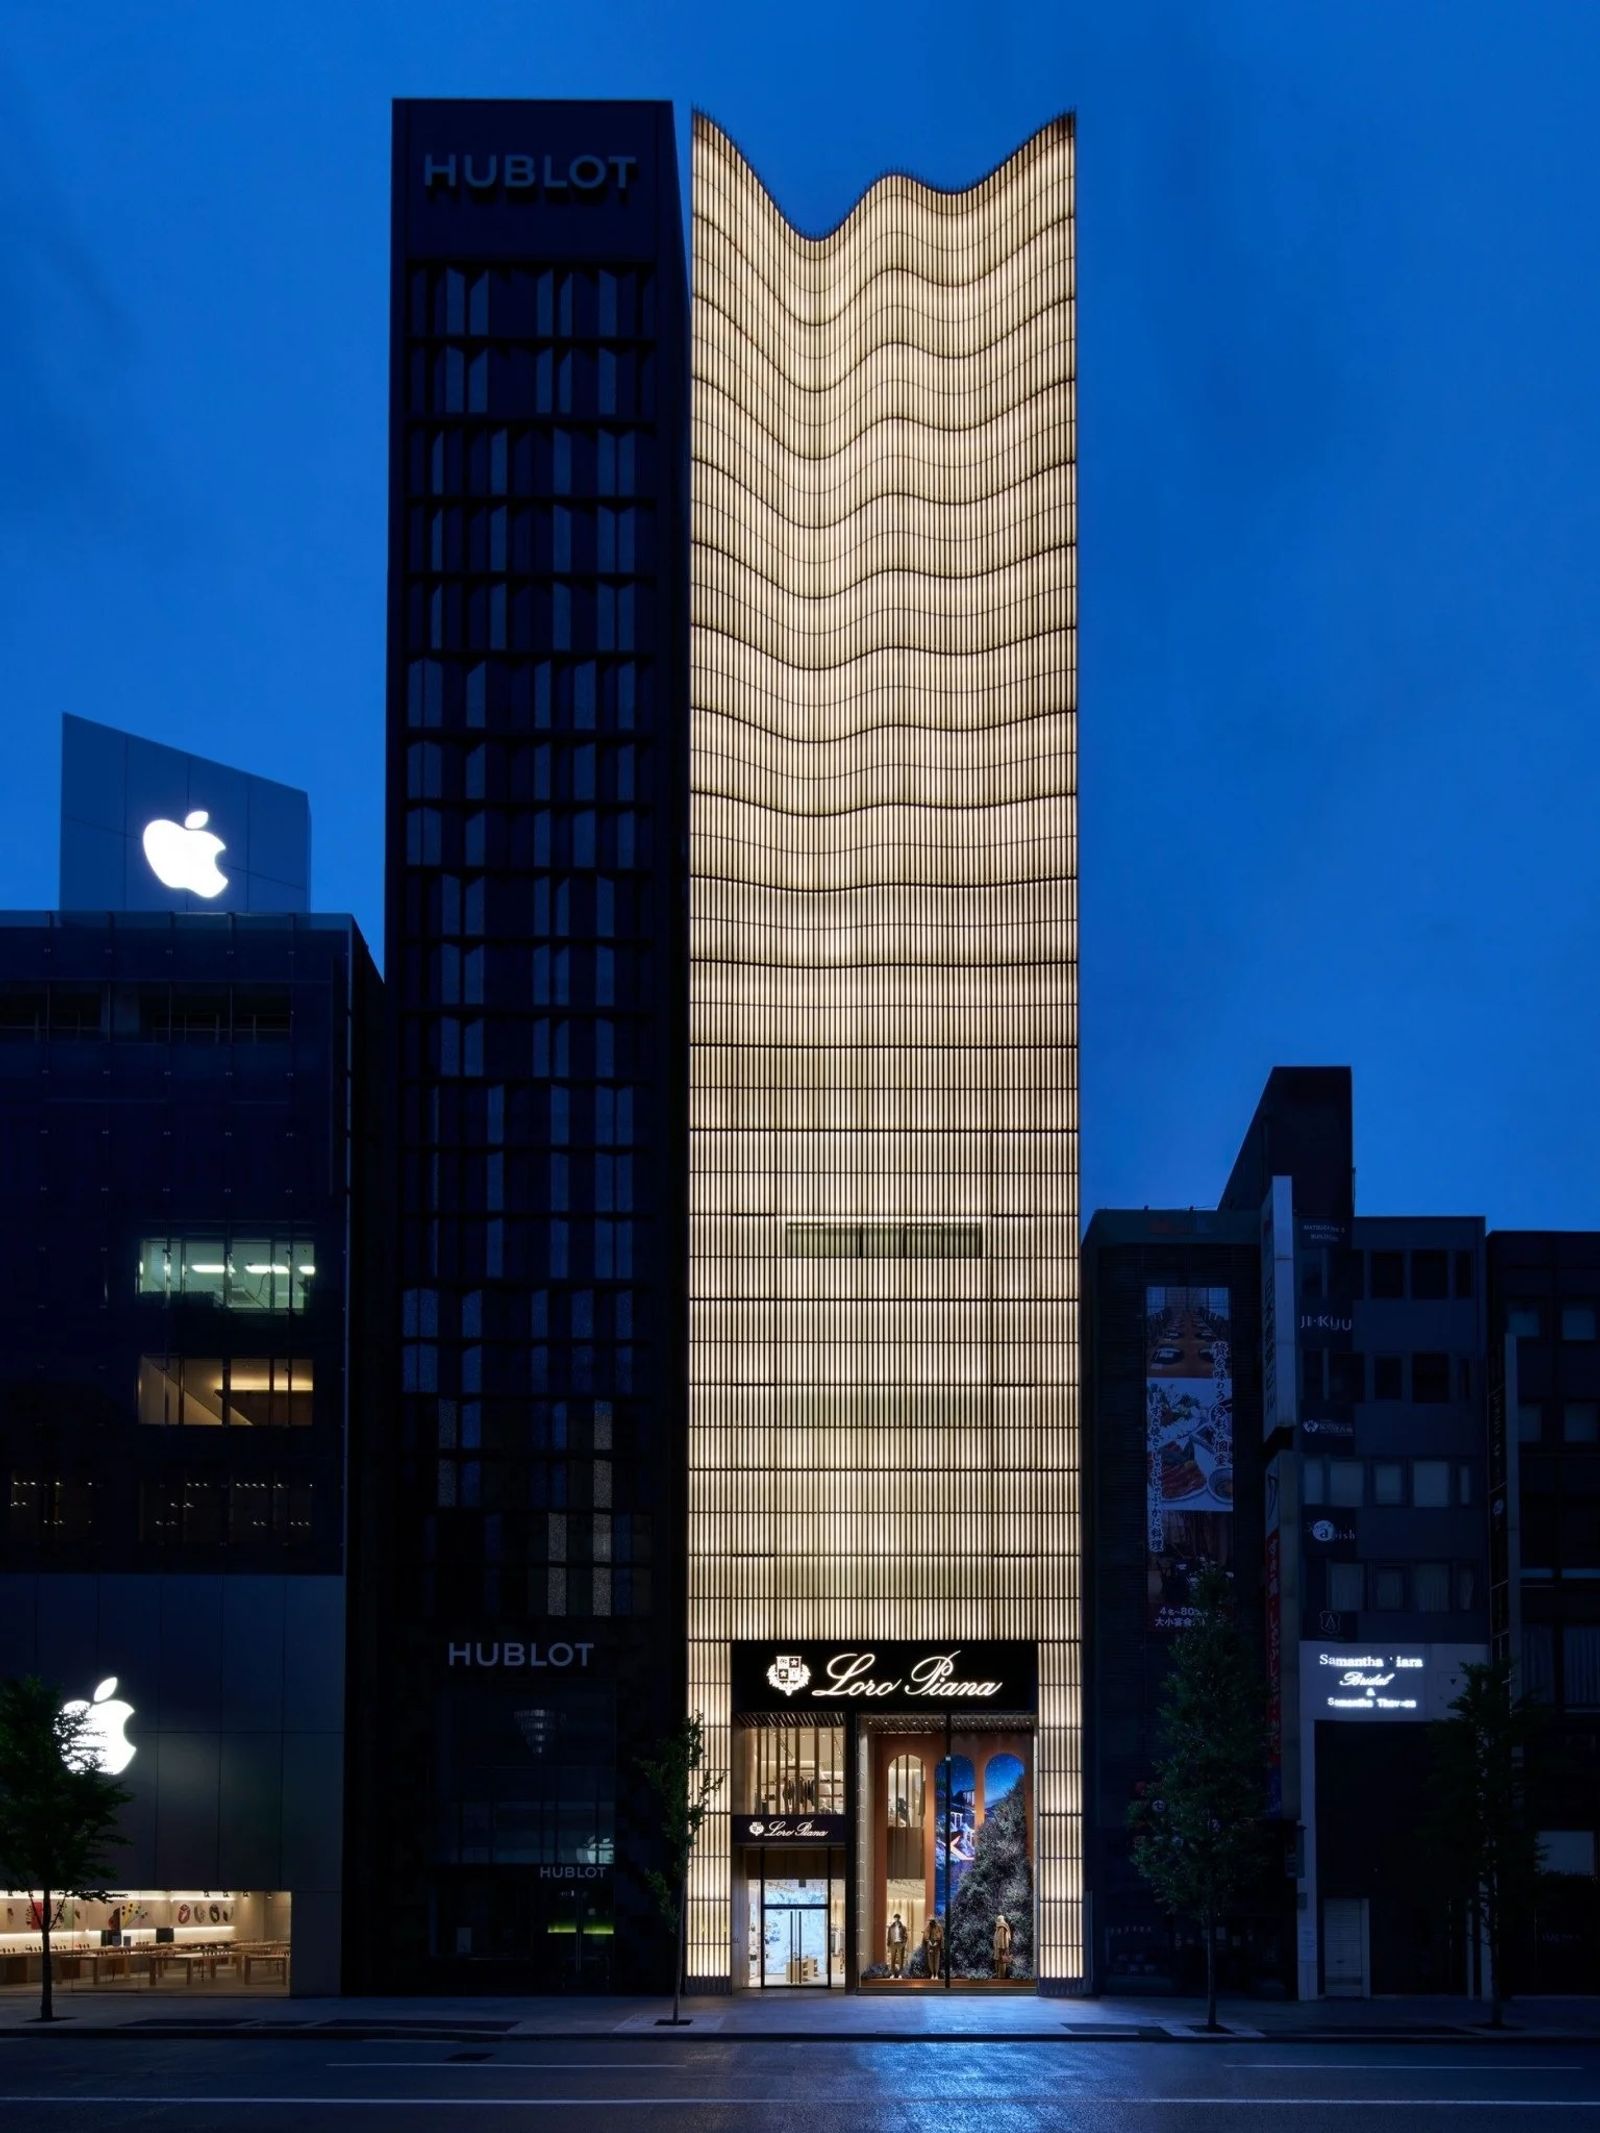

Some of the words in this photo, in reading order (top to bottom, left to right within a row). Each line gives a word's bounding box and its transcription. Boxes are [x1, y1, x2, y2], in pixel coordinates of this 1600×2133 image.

[423, 153, 638, 190] HUBLOT
[447, 1641, 595, 1668] HUBLOT
[1319, 1653, 1384, 1668] Samantha
[812, 1652, 903, 1697] Loro
[904, 1650, 1003, 1697] Piana
[1339, 1671, 1395, 1686] Bridal
[764, 1820, 794, 1837] Loro
[795, 1819, 829, 1837] Piana
[539, 1866, 607, 1879] HUBLOT
